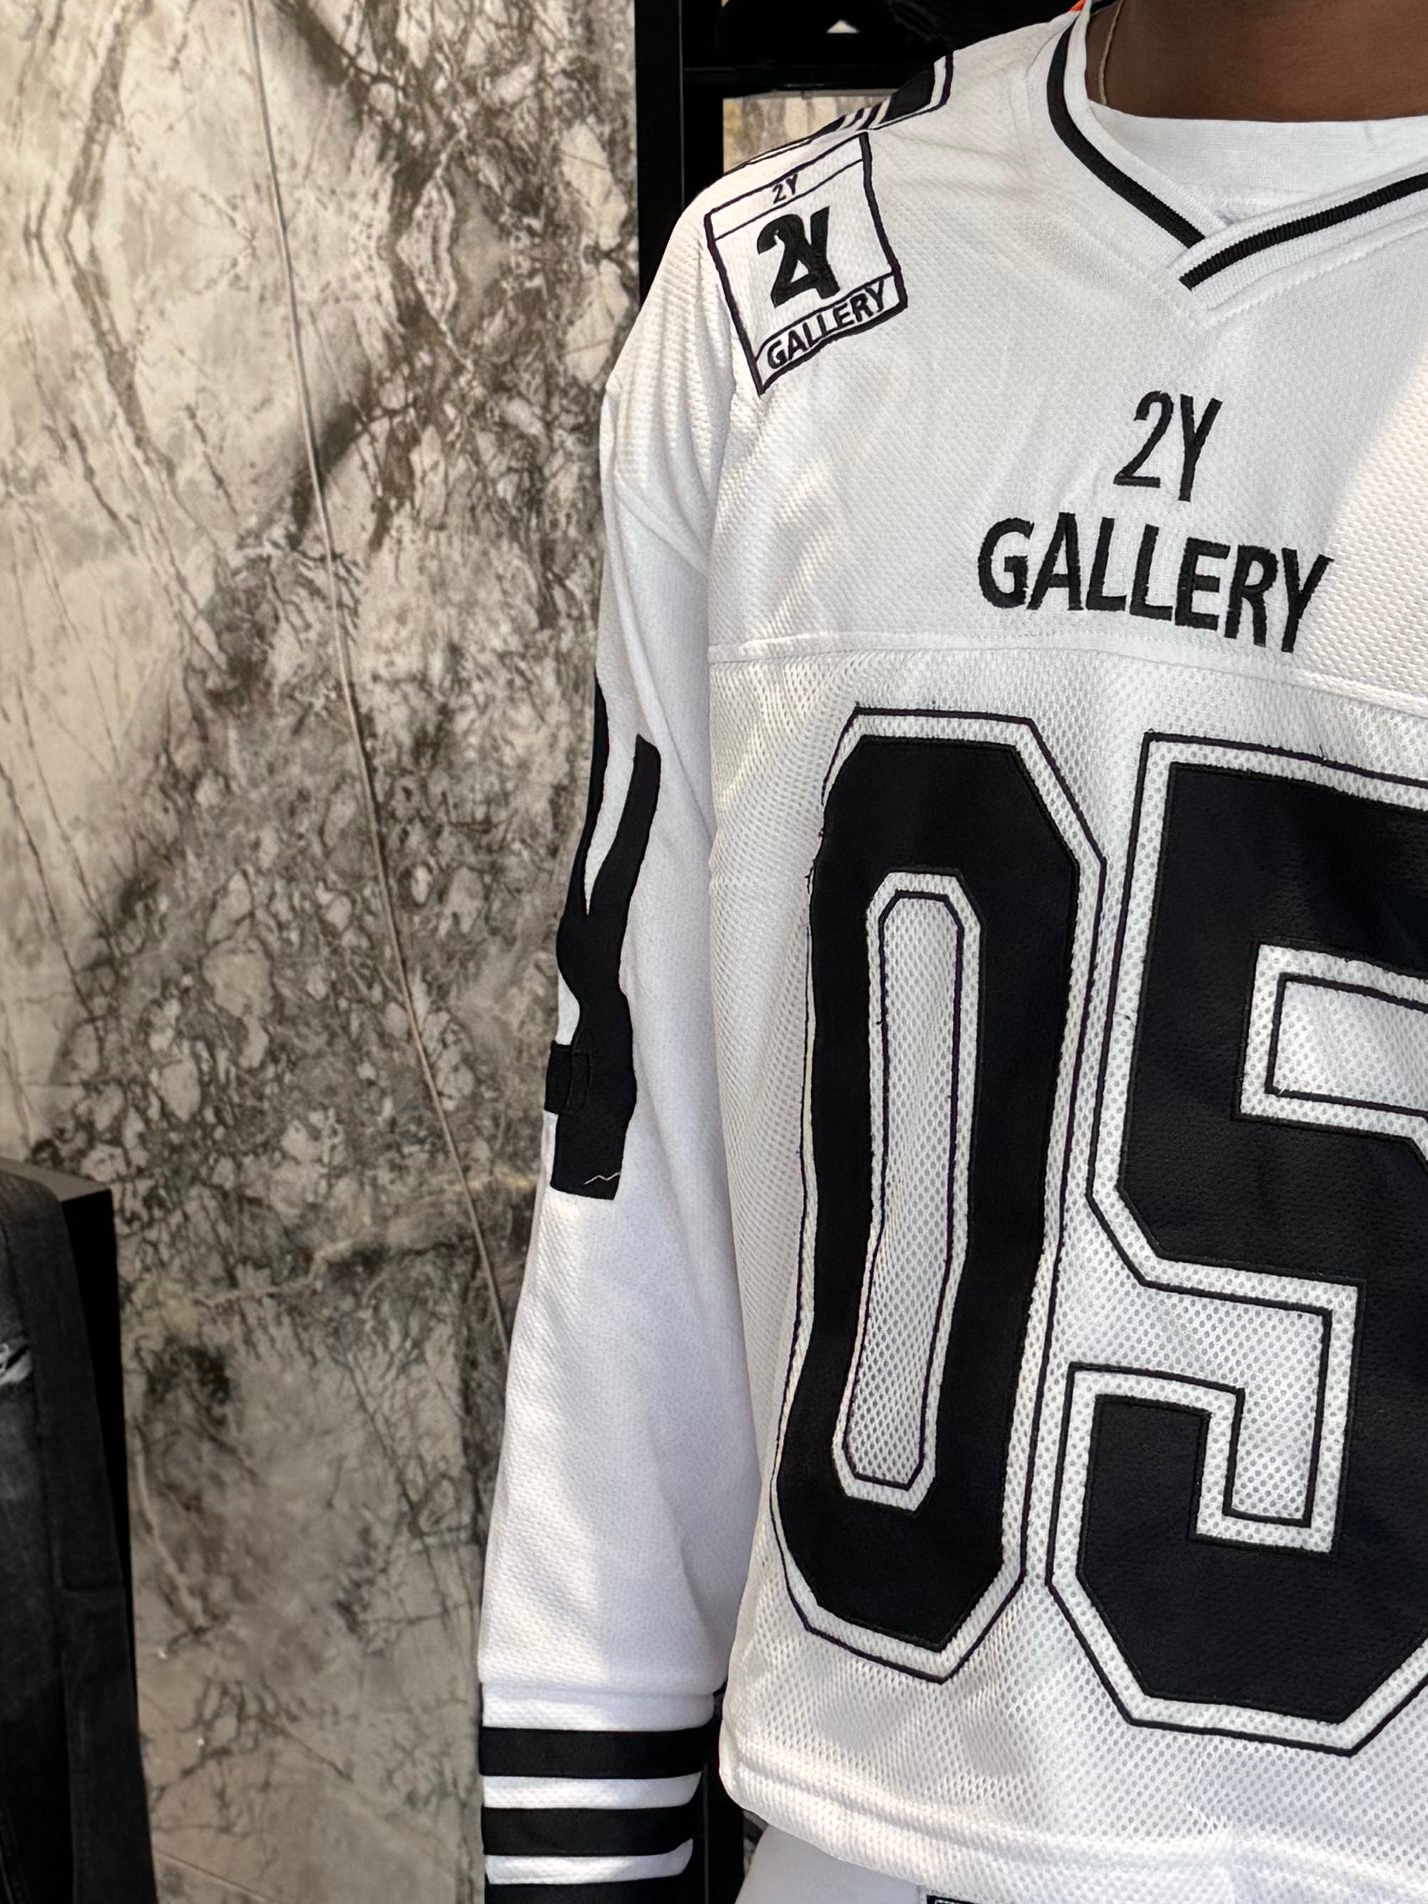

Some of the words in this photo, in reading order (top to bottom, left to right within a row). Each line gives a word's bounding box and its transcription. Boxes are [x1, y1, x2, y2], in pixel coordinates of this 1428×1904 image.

[771, 172, 799, 204] 2Y
[766, 279, 888, 371] GALLERY
[1113, 389, 1224, 502] 2Y
[976, 511, 1335, 654] GALLERY
